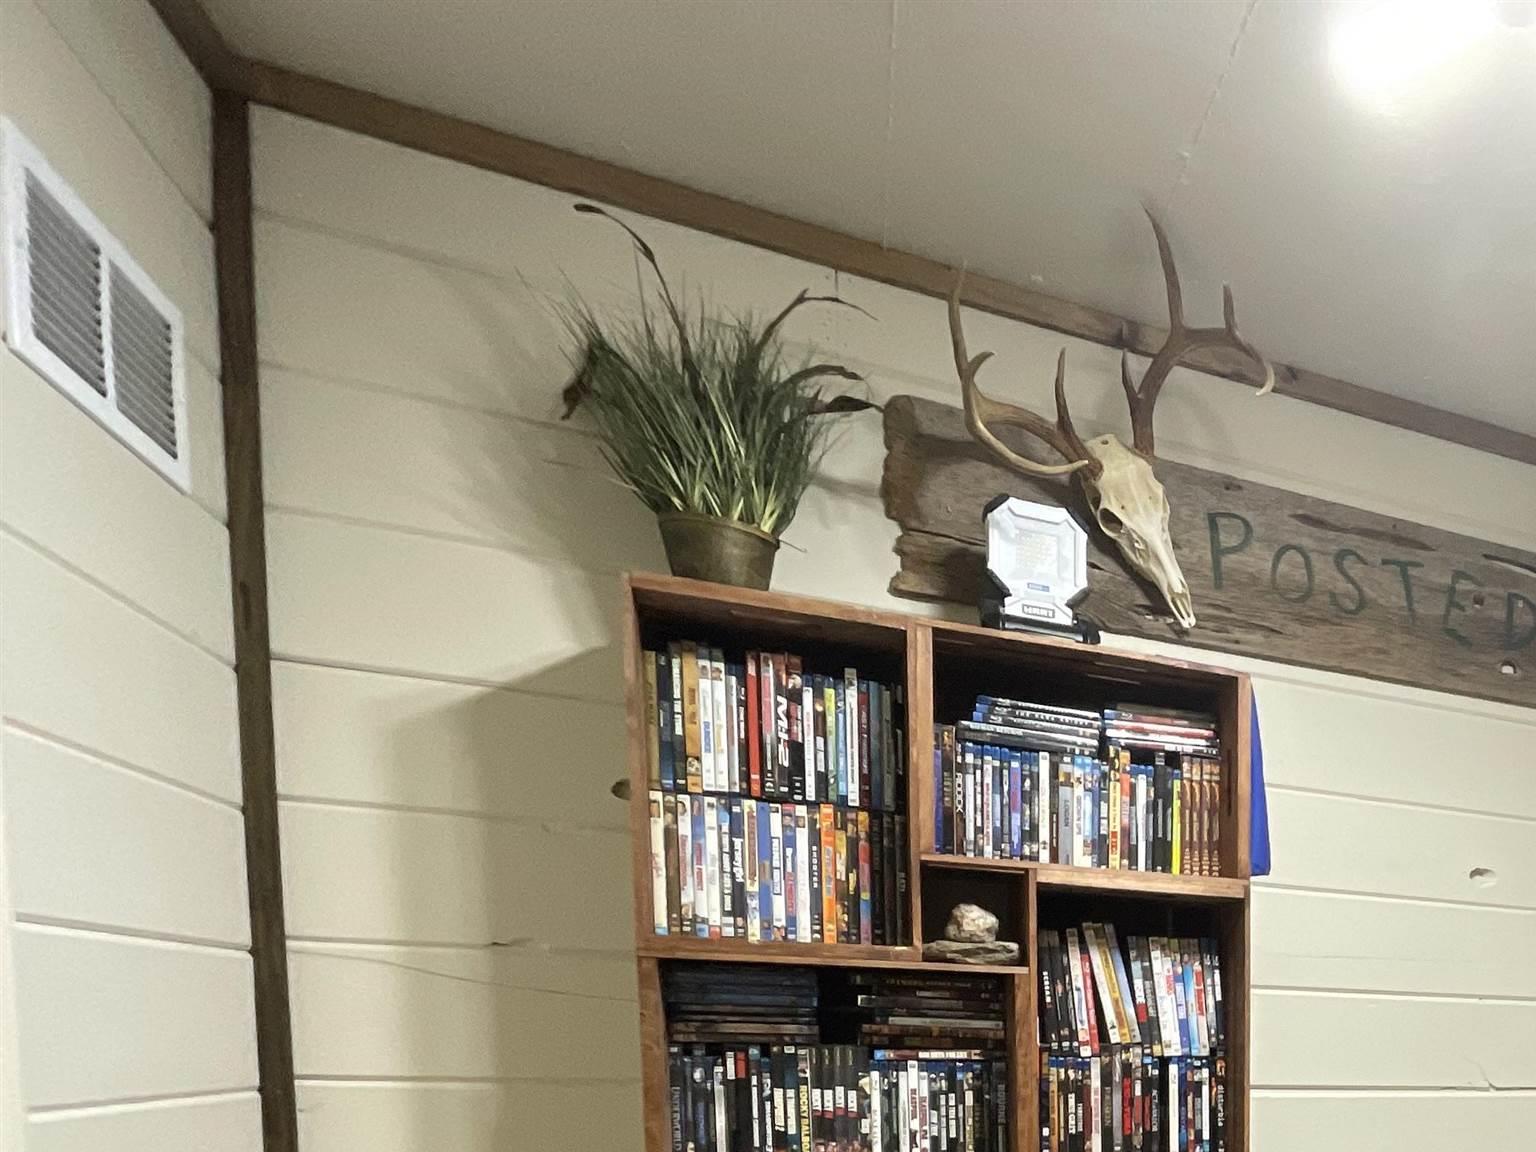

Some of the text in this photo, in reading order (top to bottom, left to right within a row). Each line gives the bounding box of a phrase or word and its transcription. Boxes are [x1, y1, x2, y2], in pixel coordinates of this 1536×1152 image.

[671, 1087, 681, 1151] UNDERWORLD
[799, 1085, 808, 1117] ROCKY
[1217, 1085, 1225, 1127] disturbia
